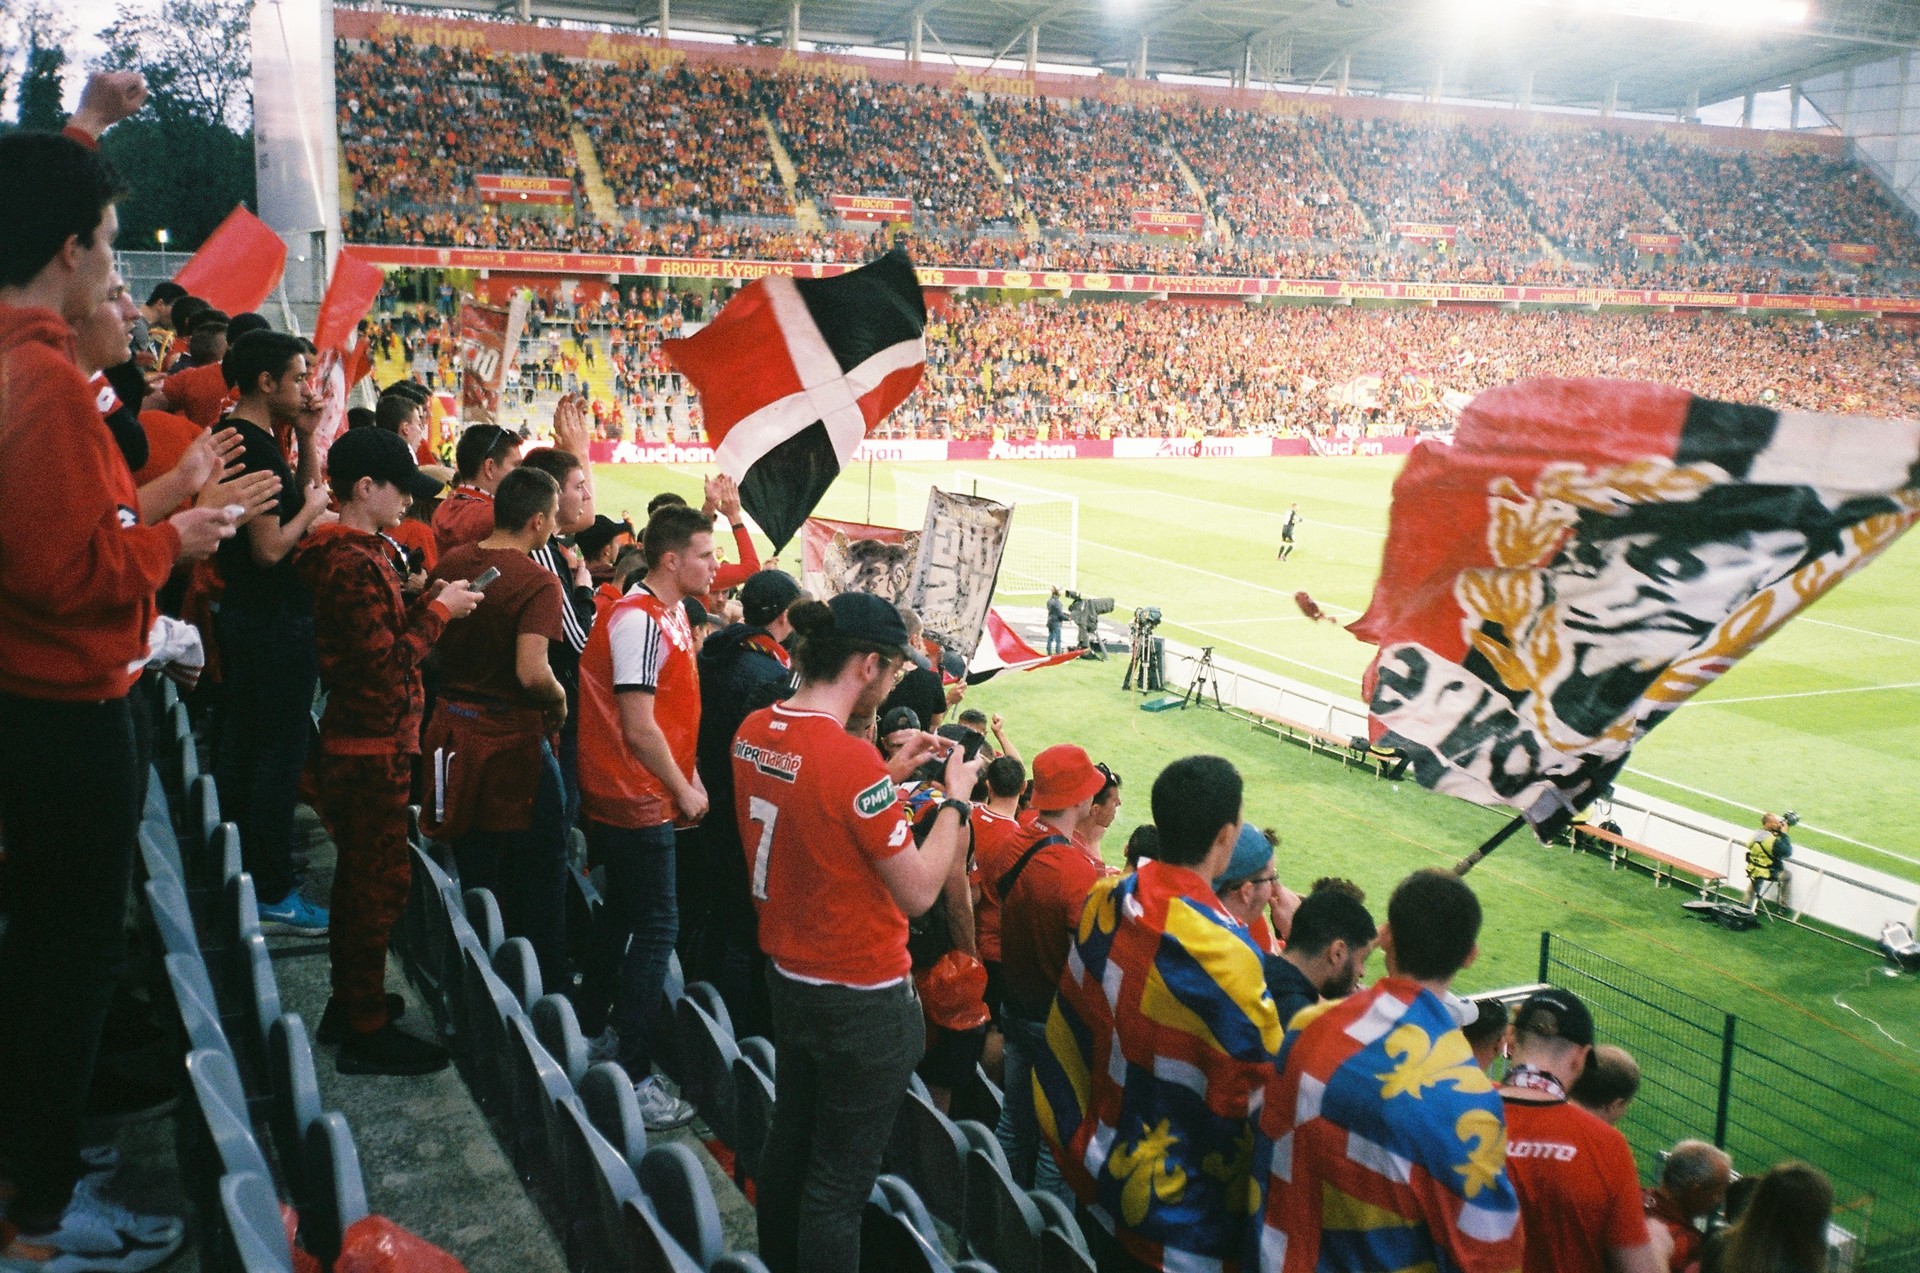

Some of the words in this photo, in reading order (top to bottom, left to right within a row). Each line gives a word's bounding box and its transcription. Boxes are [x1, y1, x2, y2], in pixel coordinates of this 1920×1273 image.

[852, 198, 894, 209] macron
[1150, 214, 1187, 224] macron
[660, 261, 719, 277] GROUPE
[1157, 277, 1193, 286] FRANCE
[1277, 280, 1325, 296] Auchan
[1338, 281, 1385, 298] Auchan
[1405, 285, 1452, 298] macron
[1459, 287, 1505, 300] macron
[611, 439, 717, 463] Auchan
[988, 439, 1077, 460] Auchan
[860, 785, 889, 812] PMU
[749, 795, 779, 900] 7
[1505, 1140, 1578, 1162] LOTTO
